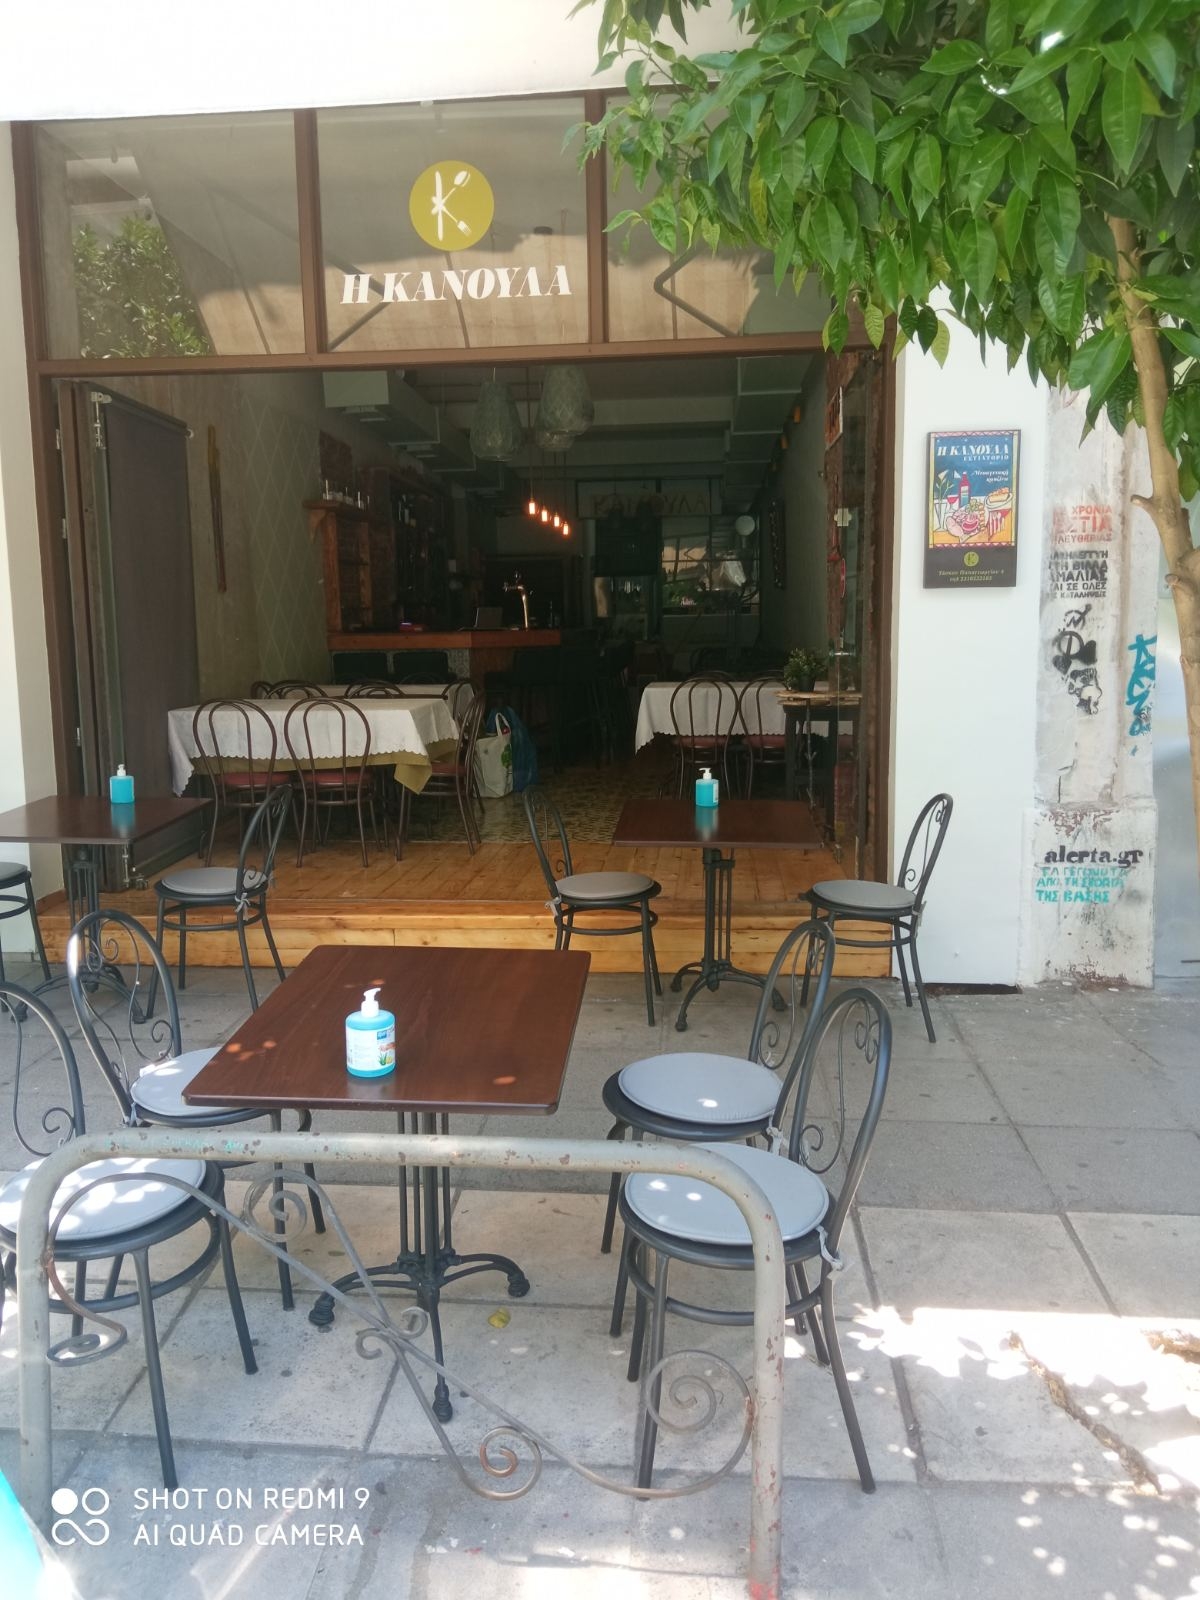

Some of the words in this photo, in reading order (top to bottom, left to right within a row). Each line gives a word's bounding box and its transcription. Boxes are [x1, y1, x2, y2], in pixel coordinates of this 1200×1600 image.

[340, 273, 373, 304] Η
[380, 264, 572, 303] ΚΑΝΟΥΛΑ
[937, 446, 948, 457] Η
[950, 443, 1009, 456] ΚΑΝΟΥΛΑ
[1066, 582, 1079, 591] ΣΕ
[1082, 581, 1107, 591] ΟΛΕΣ
[1044, 845, 1143, 868] alerta.gr
[1035, 889, 1059, 902] ΤΗΣ
[1063, 889, 1110, 903] ΒΑΣΗΣ
